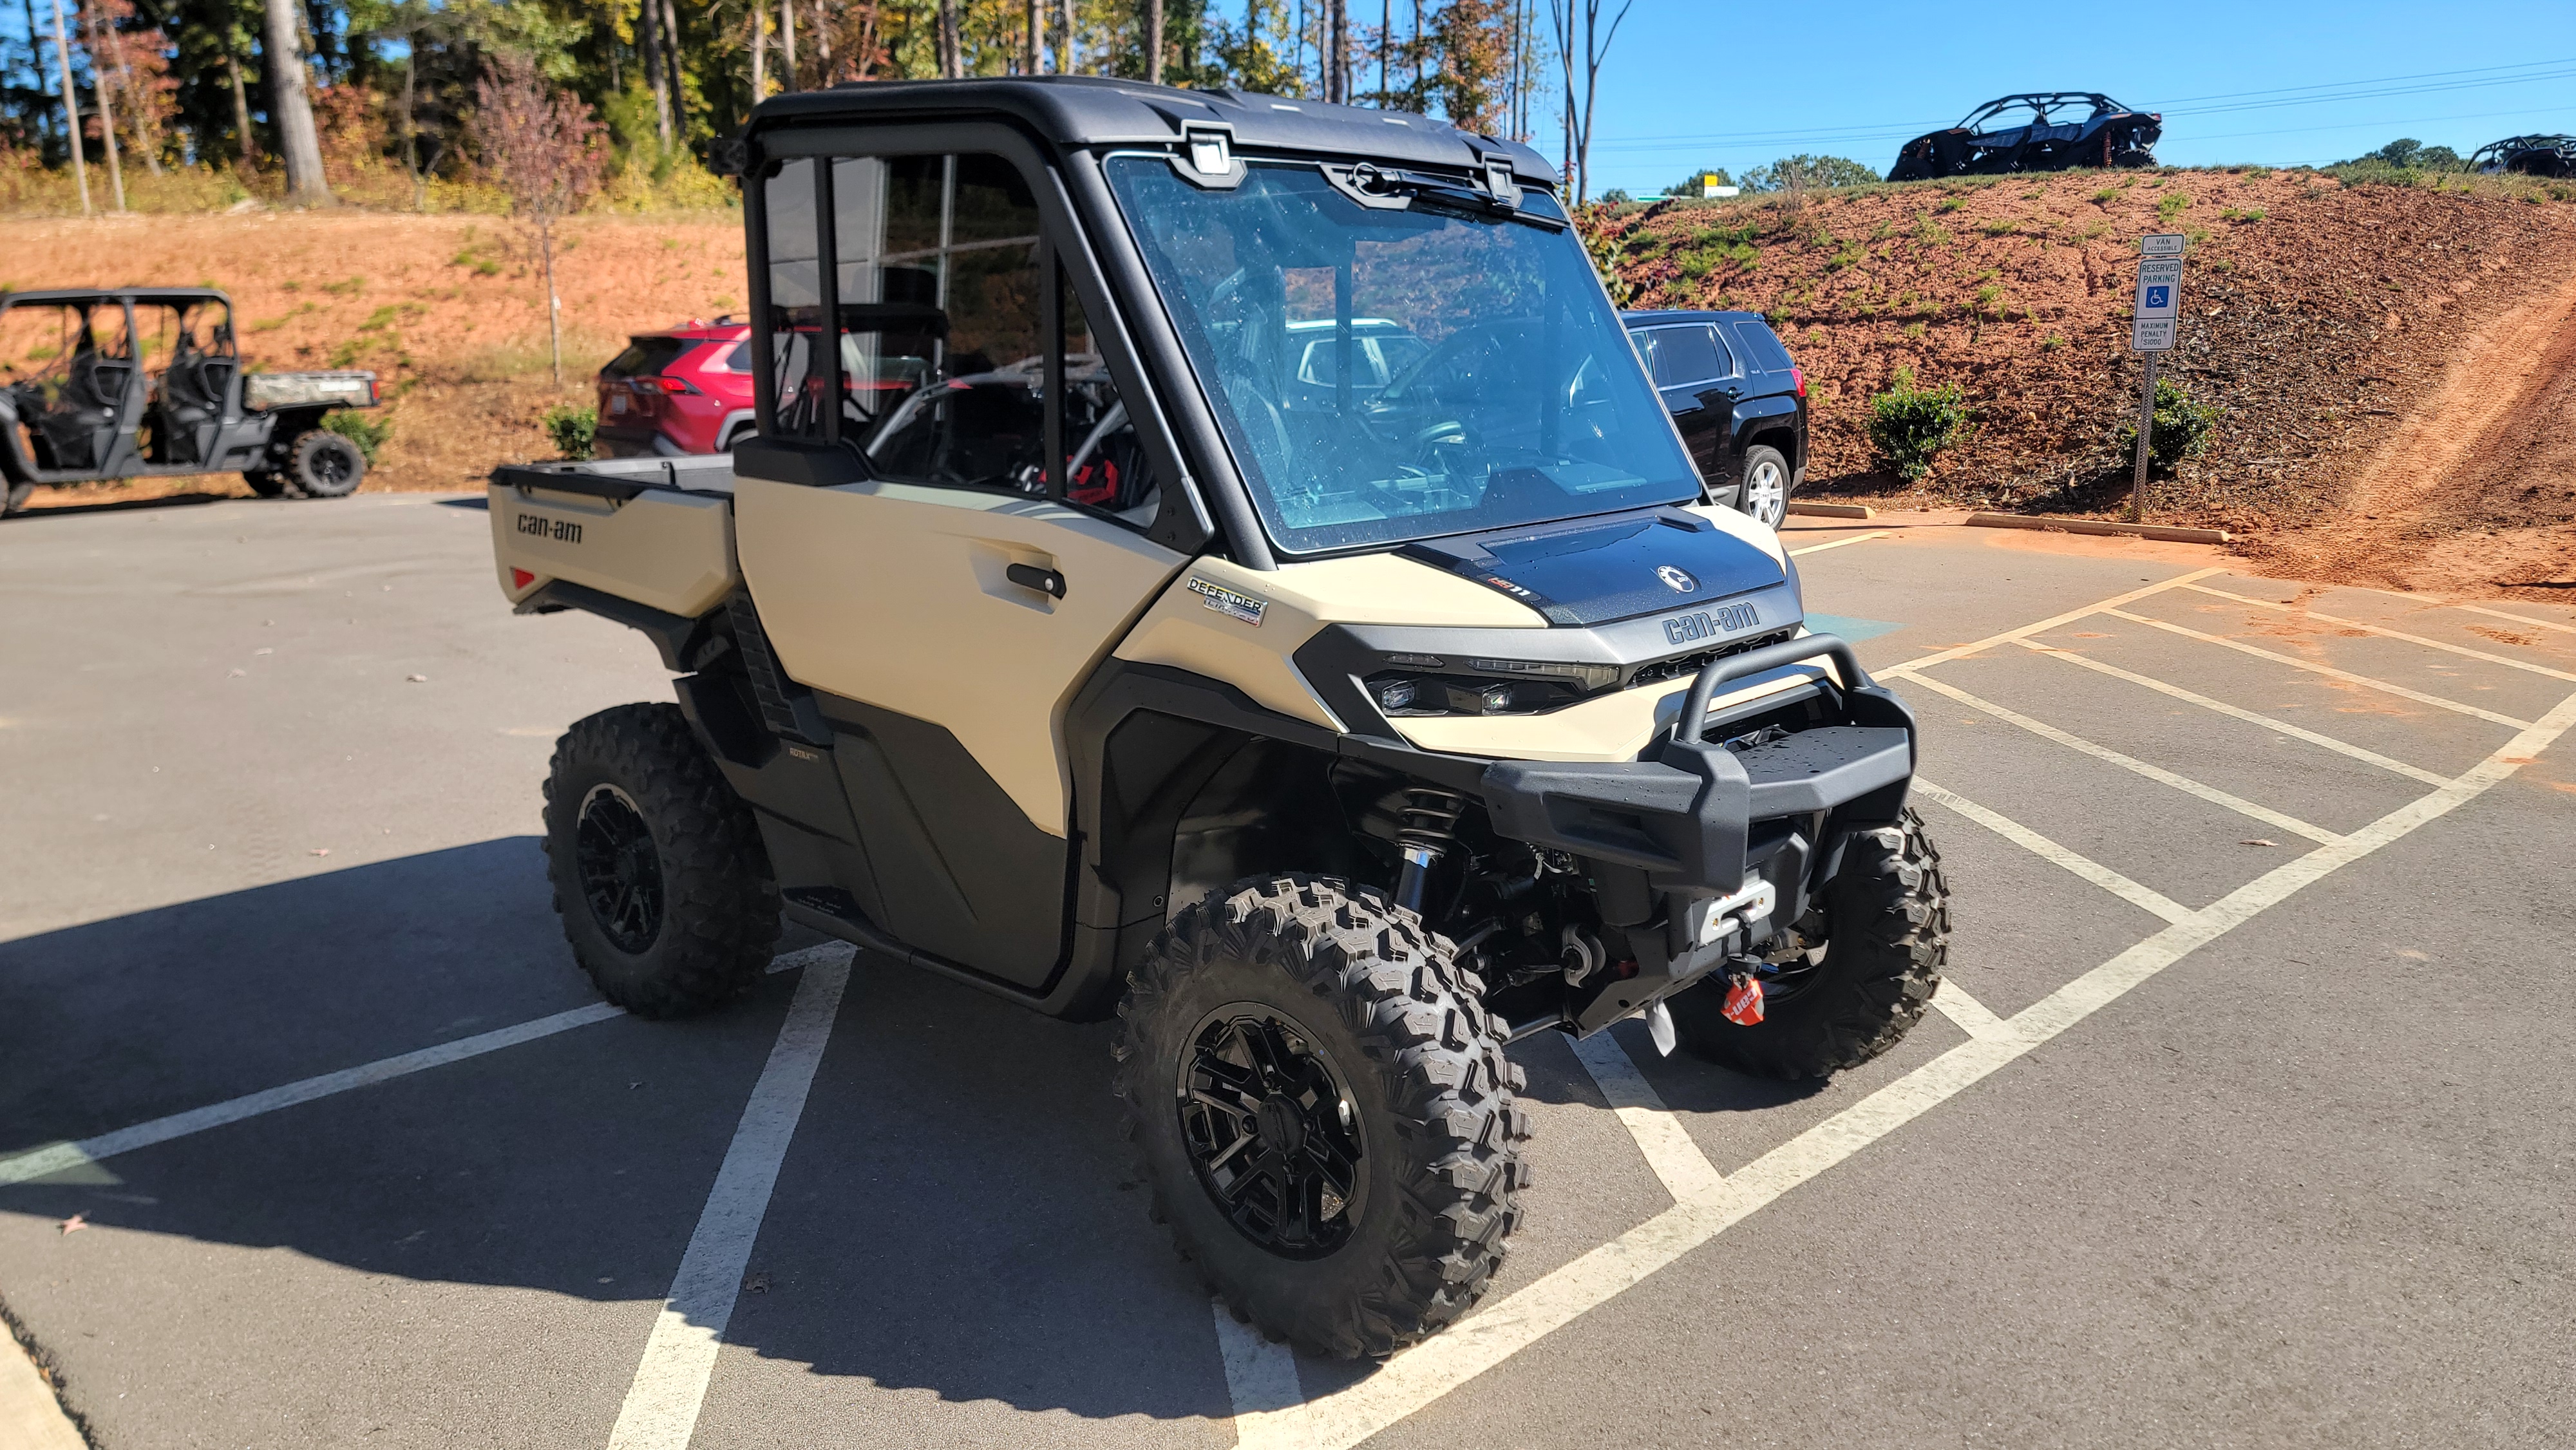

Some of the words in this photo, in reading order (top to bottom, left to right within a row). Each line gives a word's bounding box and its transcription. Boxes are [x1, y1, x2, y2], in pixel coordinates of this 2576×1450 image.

[2142, 263, 2179, 273] RESERVED
[2143, 274, 2175, 284] PARKING
[518, 514, 582, 543] can-am
[1190, 579, 1261, 612] DEFENDER
[1662, 602, 1760, 645] can-am
